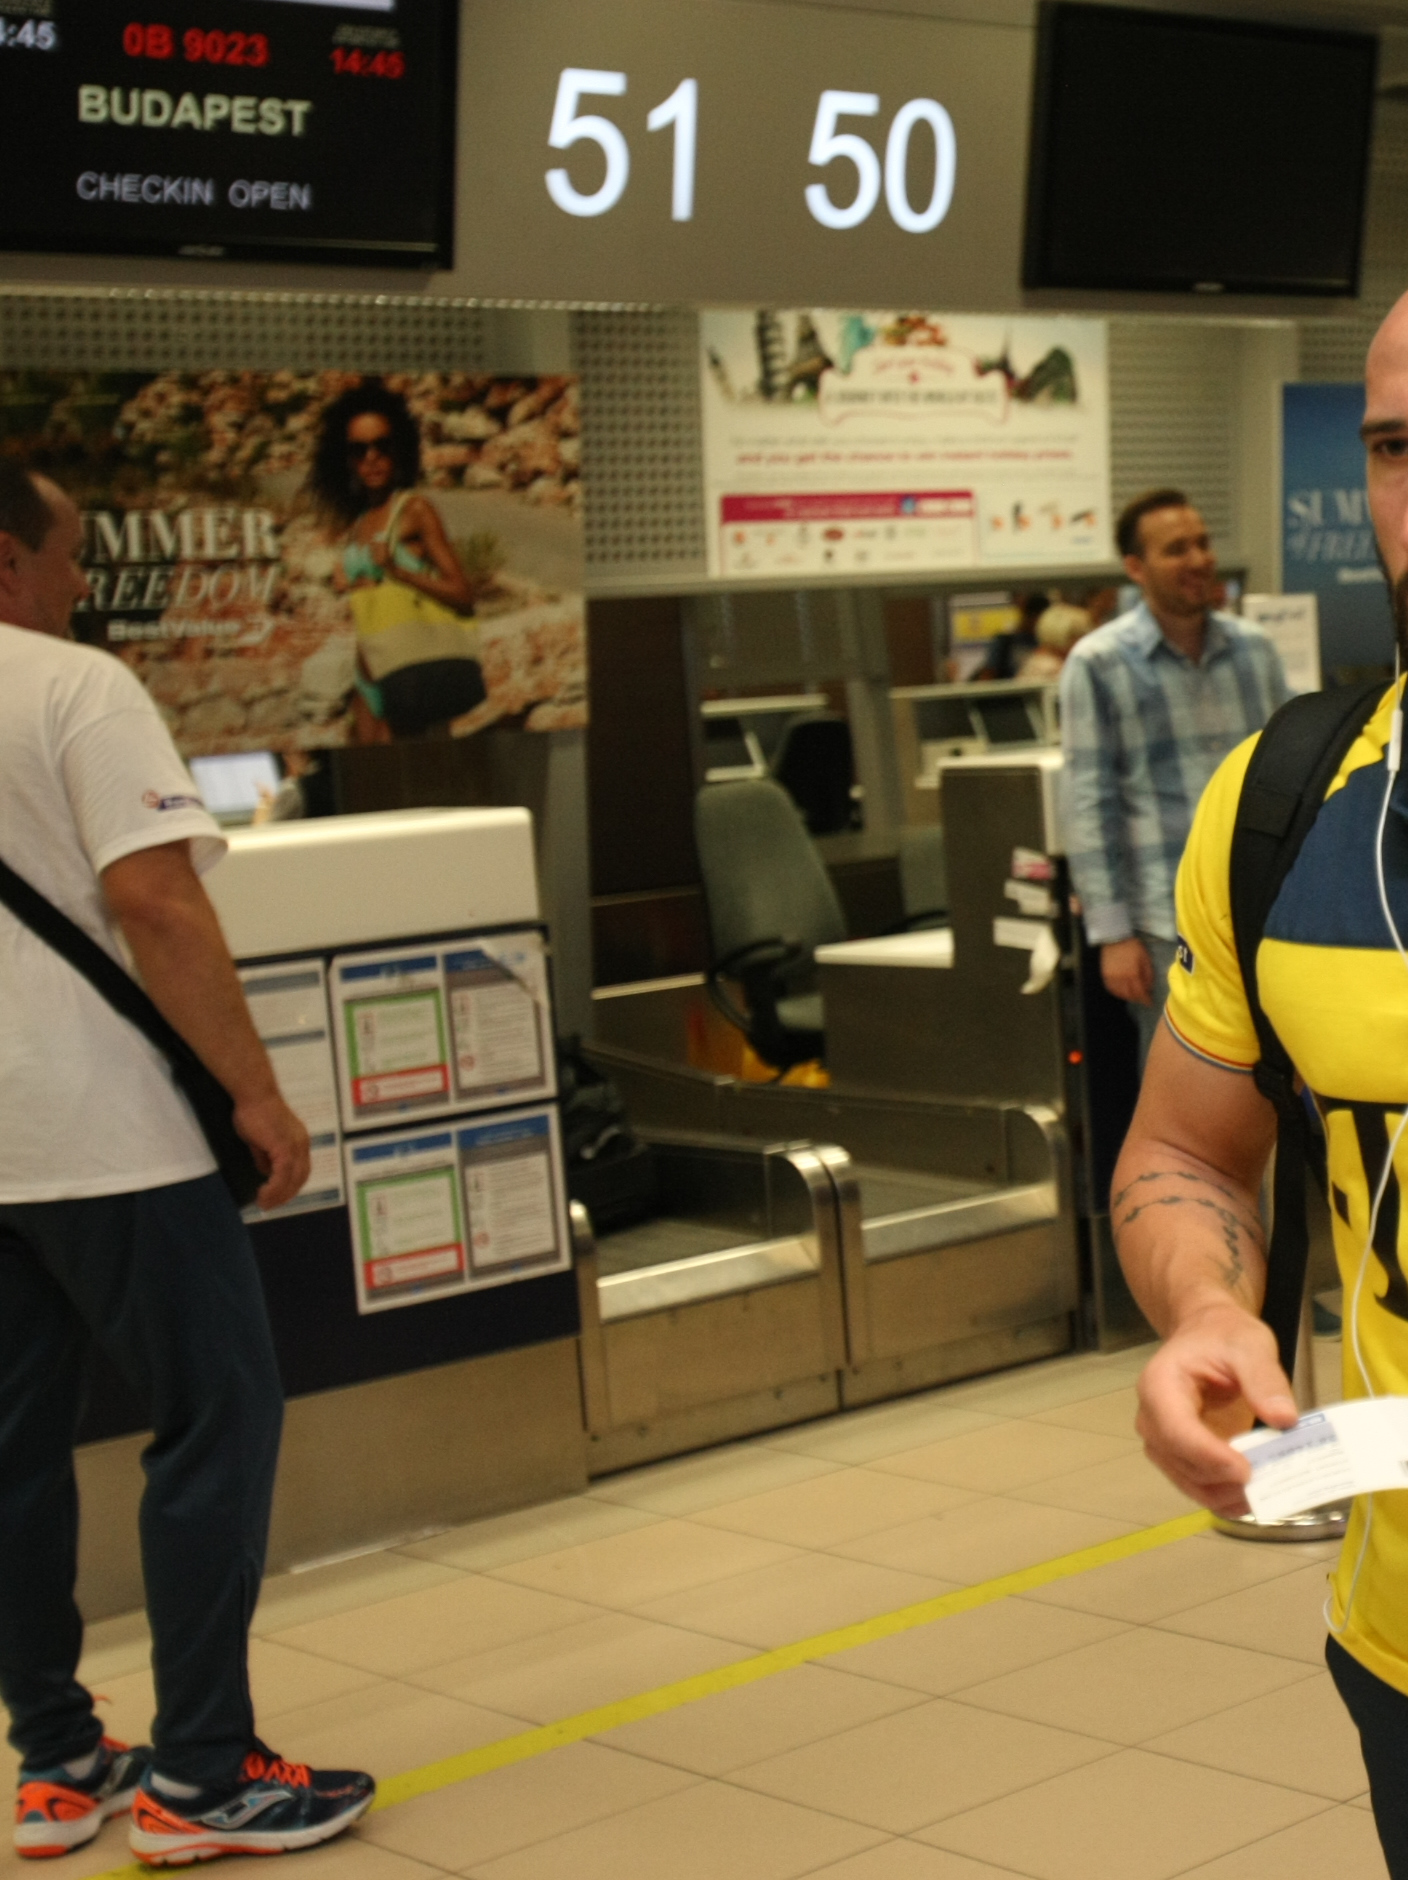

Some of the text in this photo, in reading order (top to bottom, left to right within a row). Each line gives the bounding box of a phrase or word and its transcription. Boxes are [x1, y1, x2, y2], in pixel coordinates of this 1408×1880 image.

[122, 22, 173, 60] 0B
[183, 27, 271, 67] 9023
[78, 84, 311, 136] BUDAPEST
[545, 67, 698, 222] 51
[804, 89, 957, 234] 50
[75, 170, 312, 211] CHECKIN OPEN
[79, 509, 281, 563] MMER
